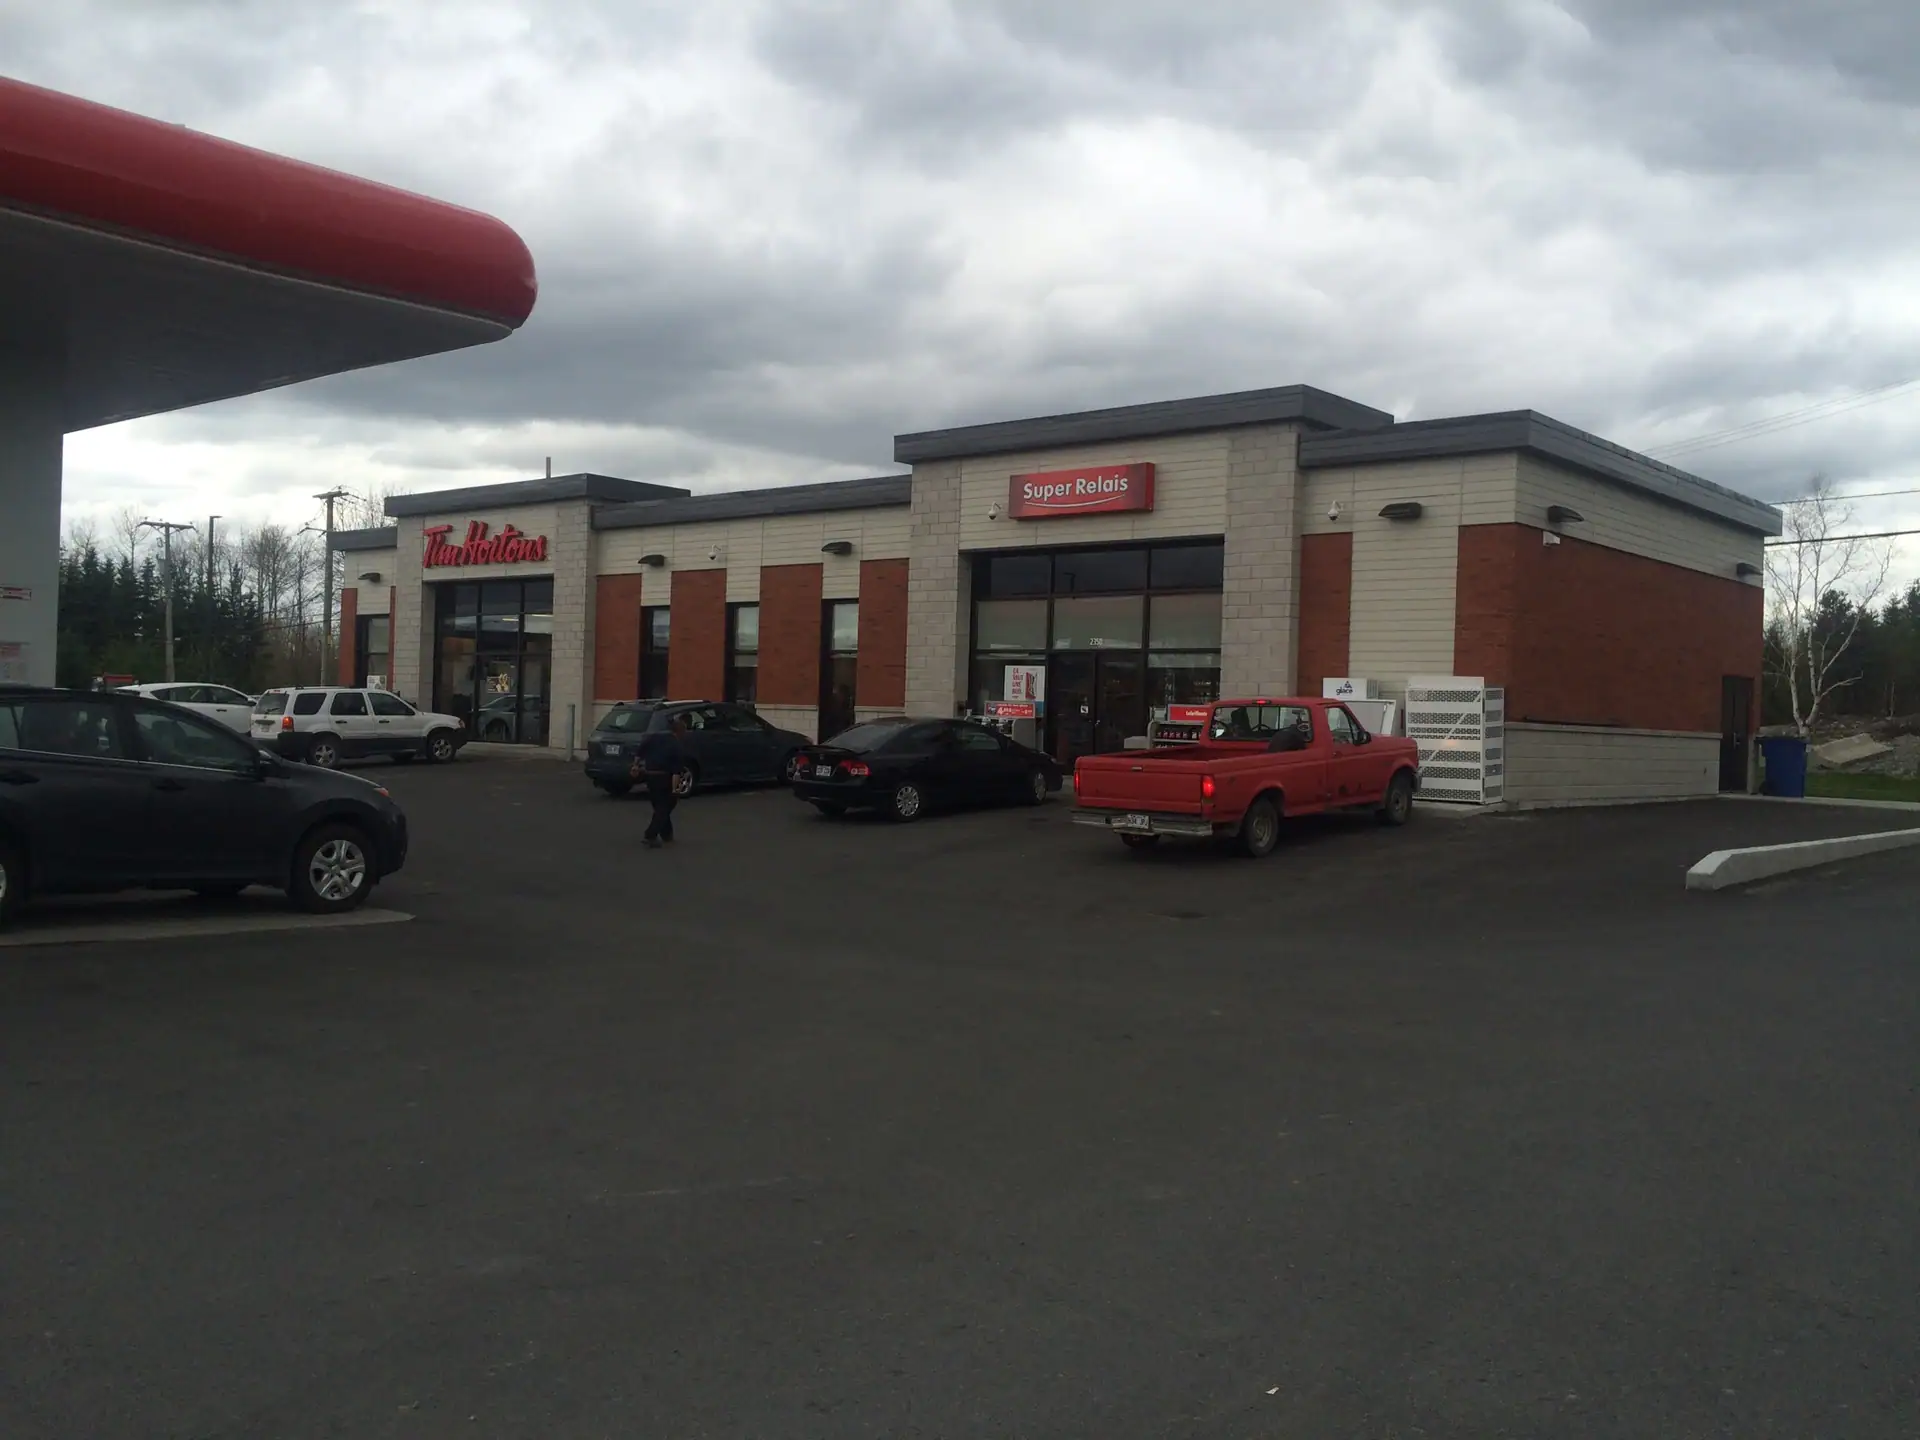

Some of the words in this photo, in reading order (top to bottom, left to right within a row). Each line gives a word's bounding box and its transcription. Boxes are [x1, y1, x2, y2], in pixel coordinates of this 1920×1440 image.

[1023, 482, 1072, 501] Super
[1076, 474, 1128, 494] Relais
[423, 524, 462, 568] Tim
[462, 520, 547, 565] Hortons
[1336, 686, 1353, 695] glace
